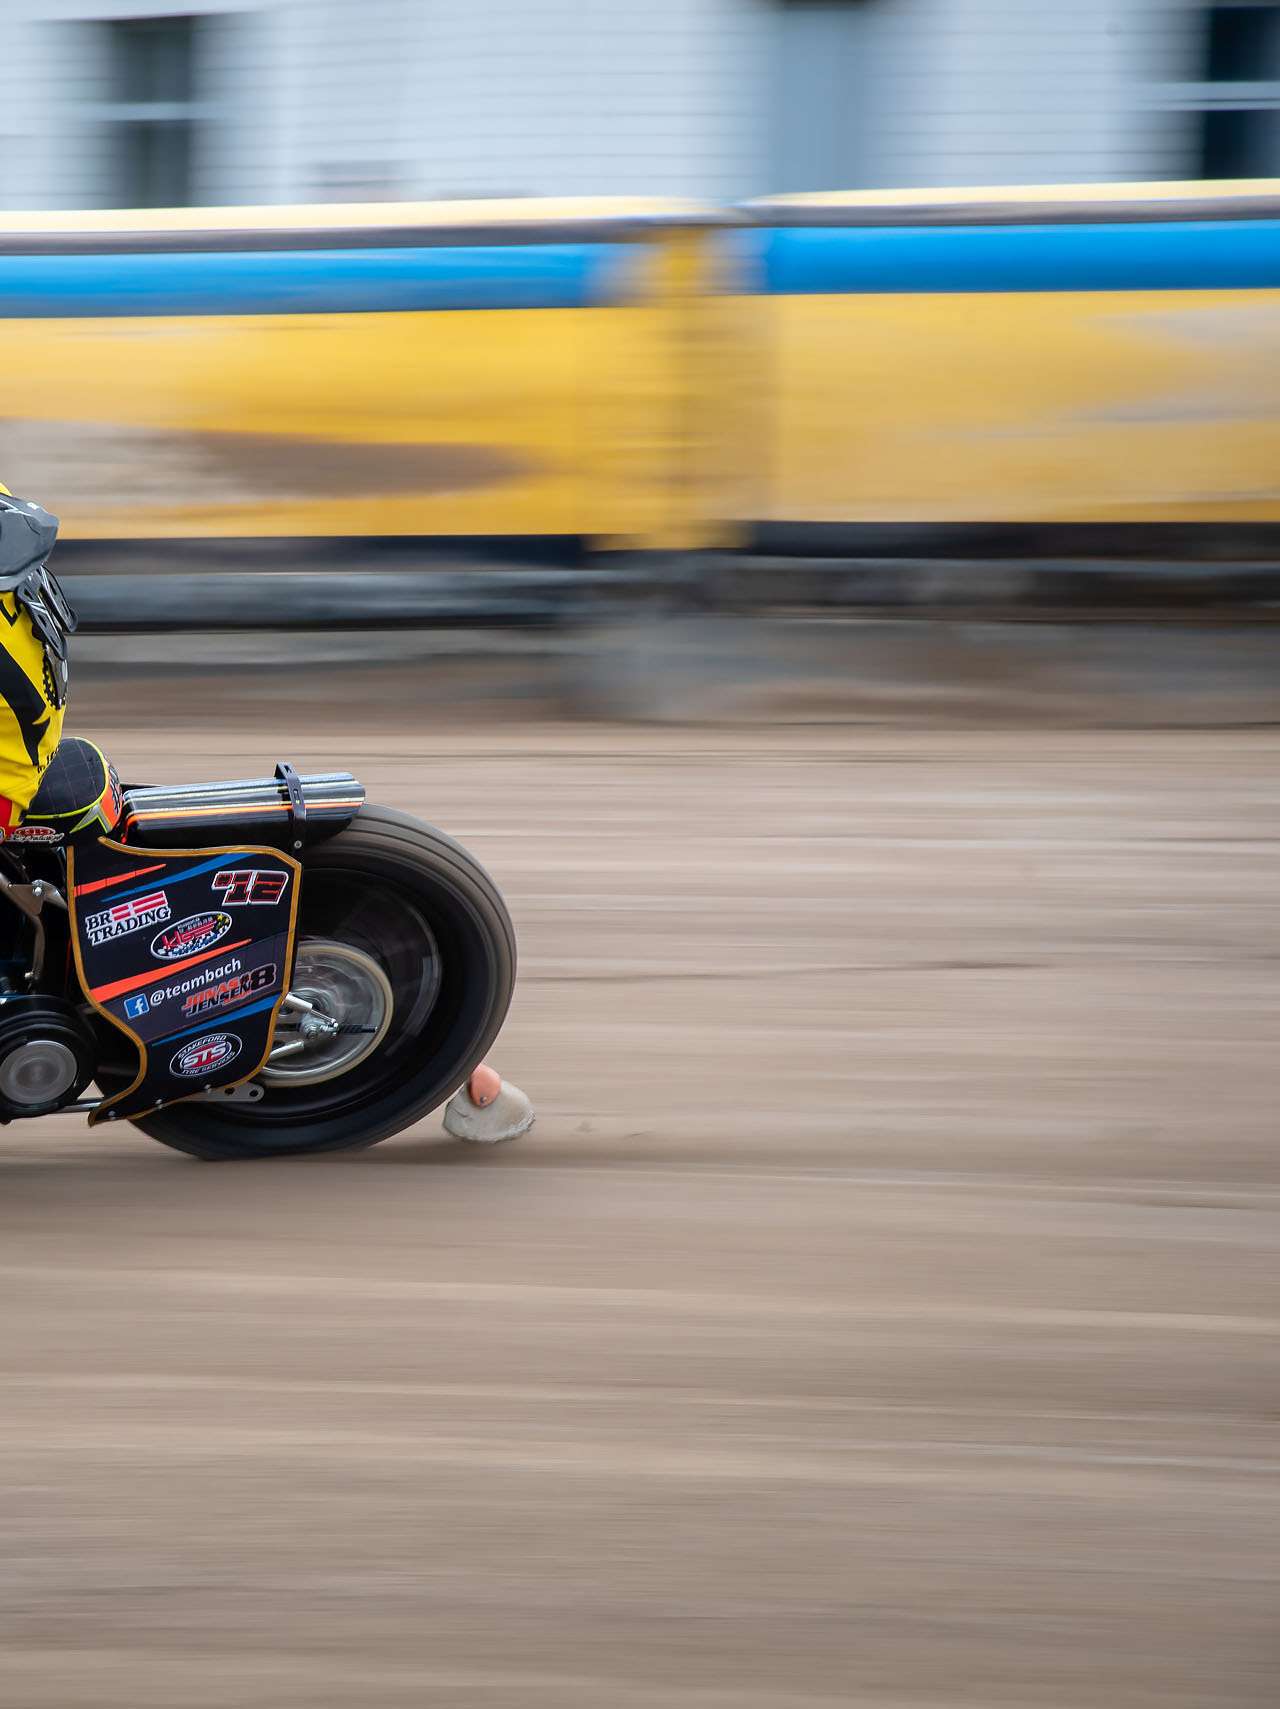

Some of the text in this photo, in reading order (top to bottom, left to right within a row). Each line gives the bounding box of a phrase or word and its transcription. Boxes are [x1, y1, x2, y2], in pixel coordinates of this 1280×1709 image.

[89, 906, 170, 943] TRADING
[150, 958, 241, 1006] @teambach
[183, 1042, 227, 1068] STS
